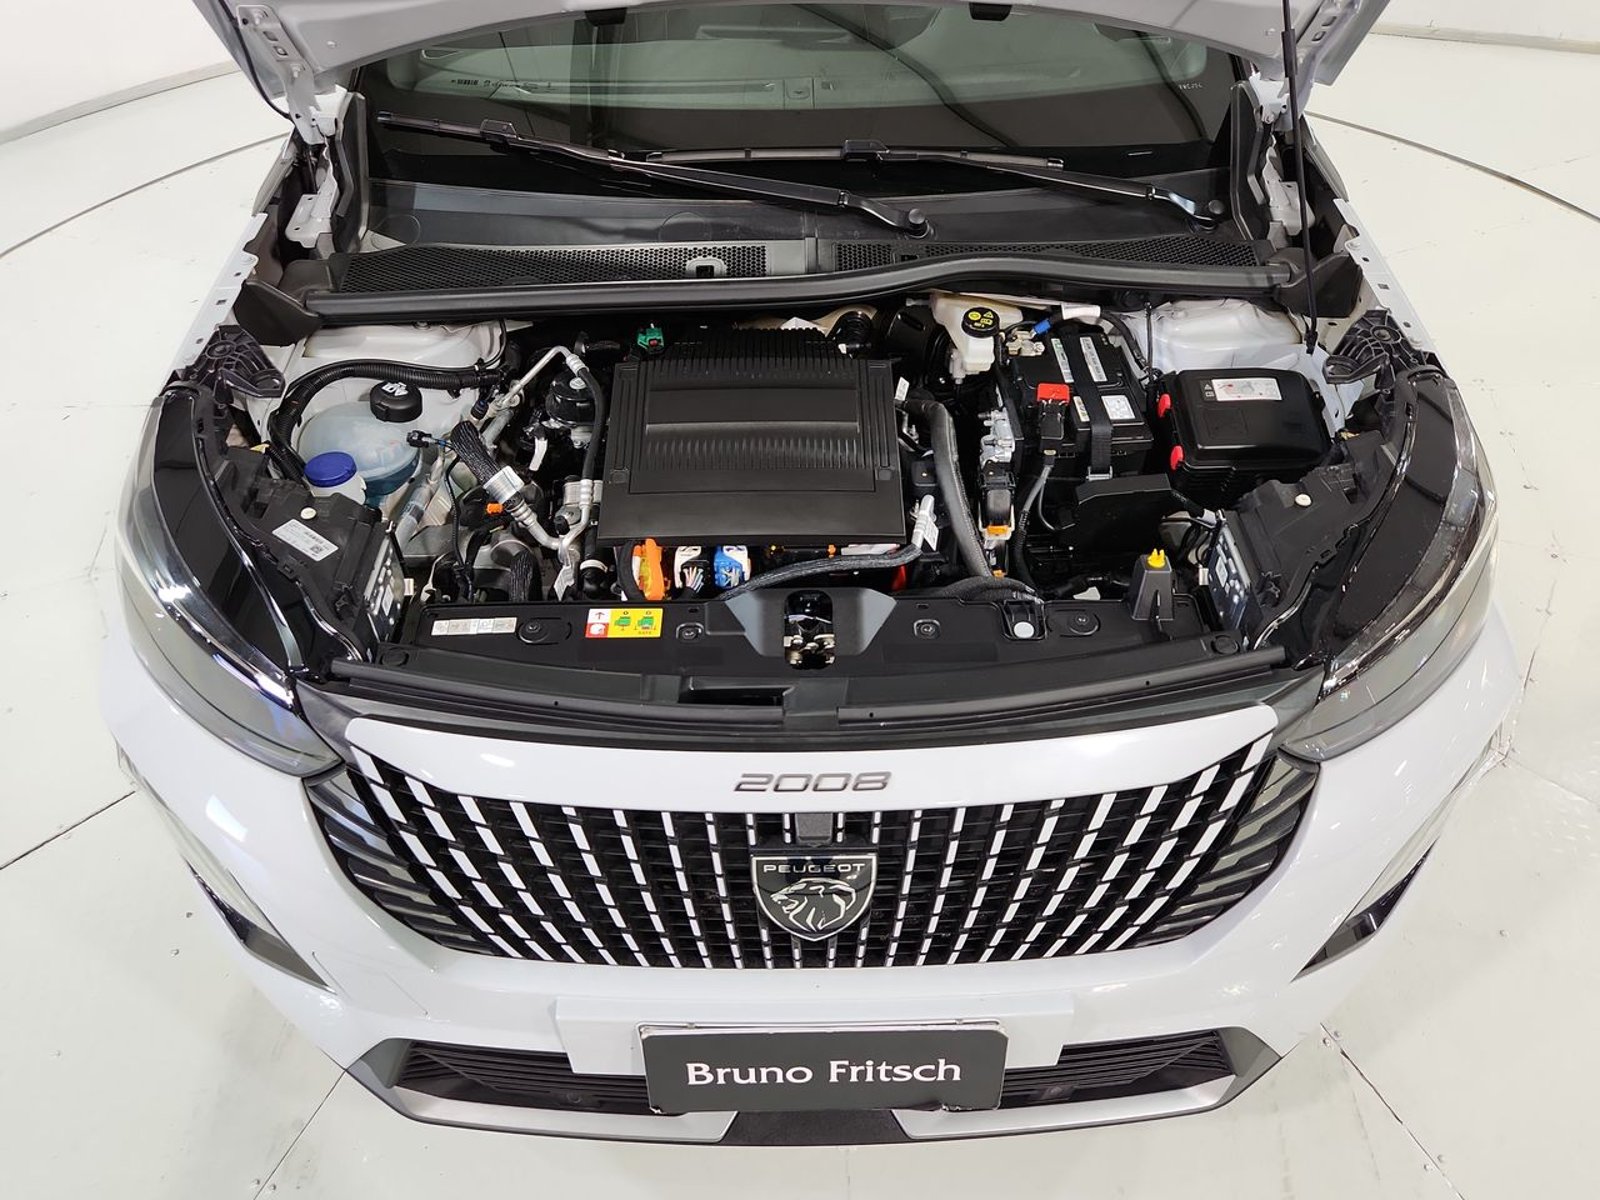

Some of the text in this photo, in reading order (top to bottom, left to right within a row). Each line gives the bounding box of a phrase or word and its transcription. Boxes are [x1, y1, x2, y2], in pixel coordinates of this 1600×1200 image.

[734, 772, 891, 792] 2008
[763, 863, 865, 873] PEUGEOT
[686, 1058, 961, 1085] Bruno Fritsch
